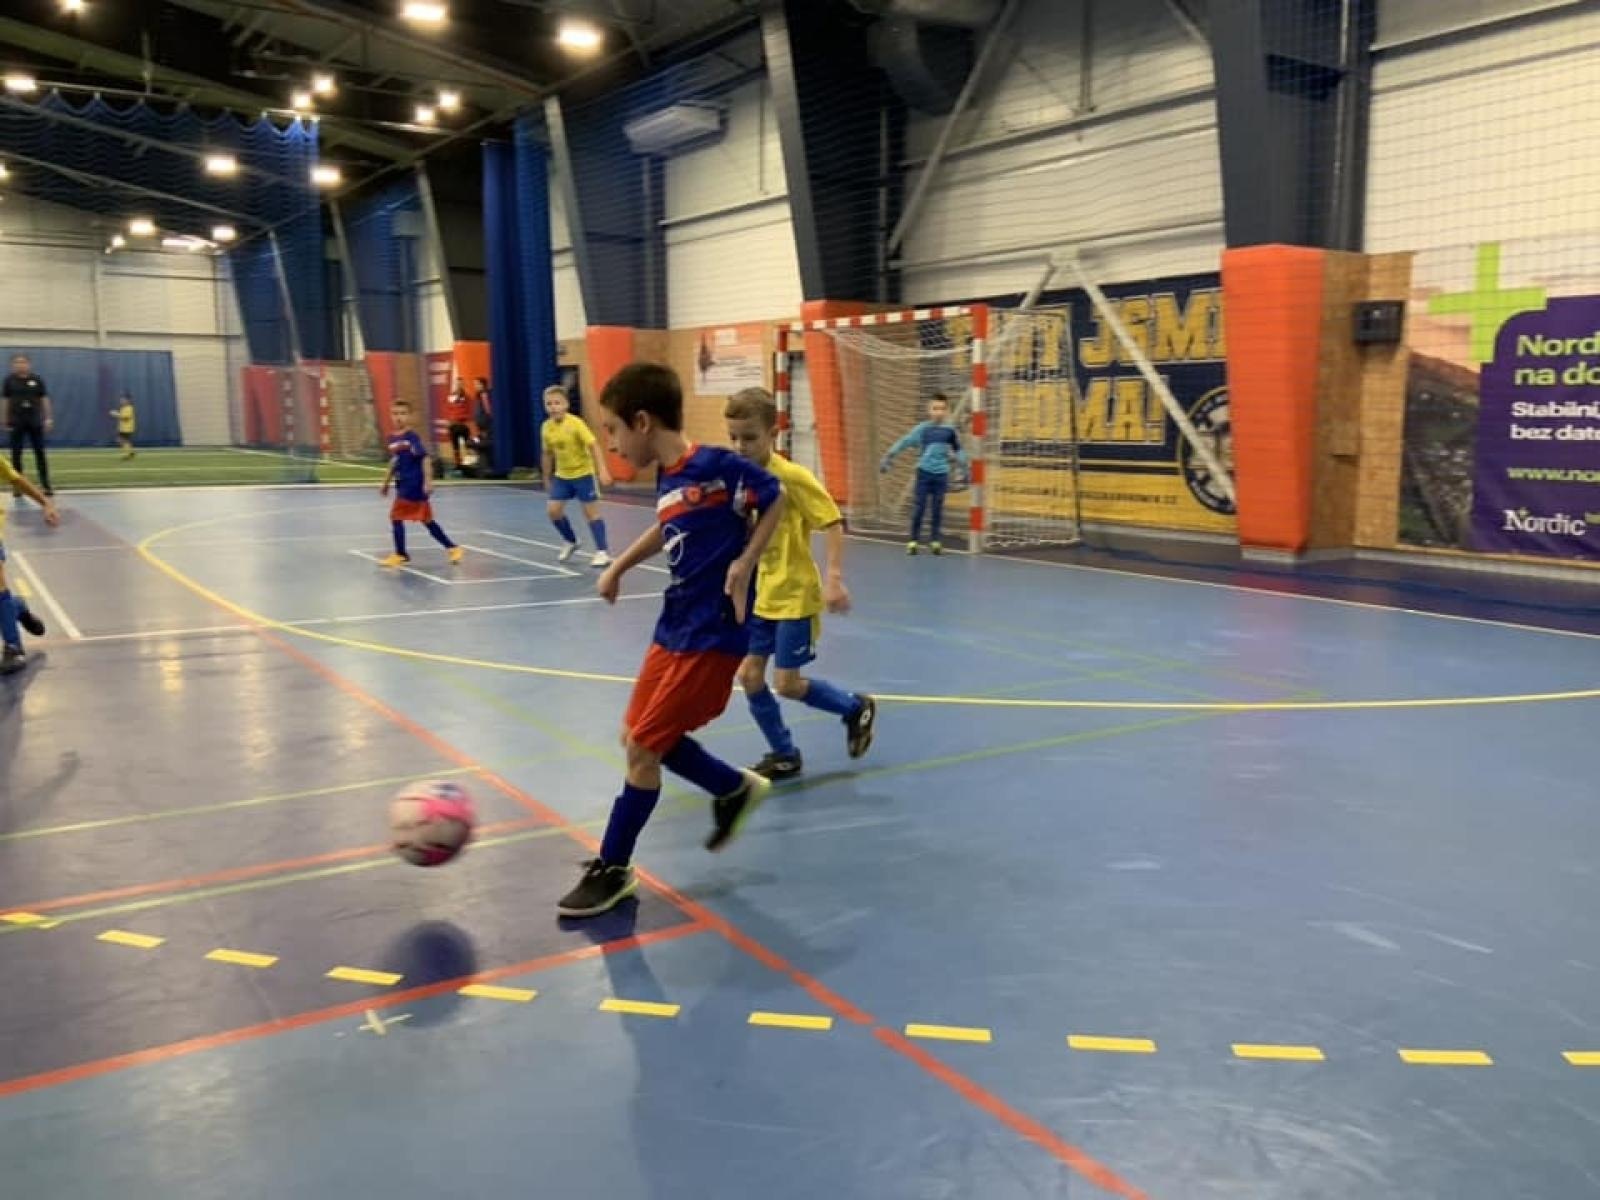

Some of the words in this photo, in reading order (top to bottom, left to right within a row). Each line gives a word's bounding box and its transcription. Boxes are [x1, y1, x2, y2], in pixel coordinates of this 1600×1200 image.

[1514, 368, 1555, 386] na
[1510, 424, 1553, 440] bez
[1502, 510, 1587, 536] Nordic
